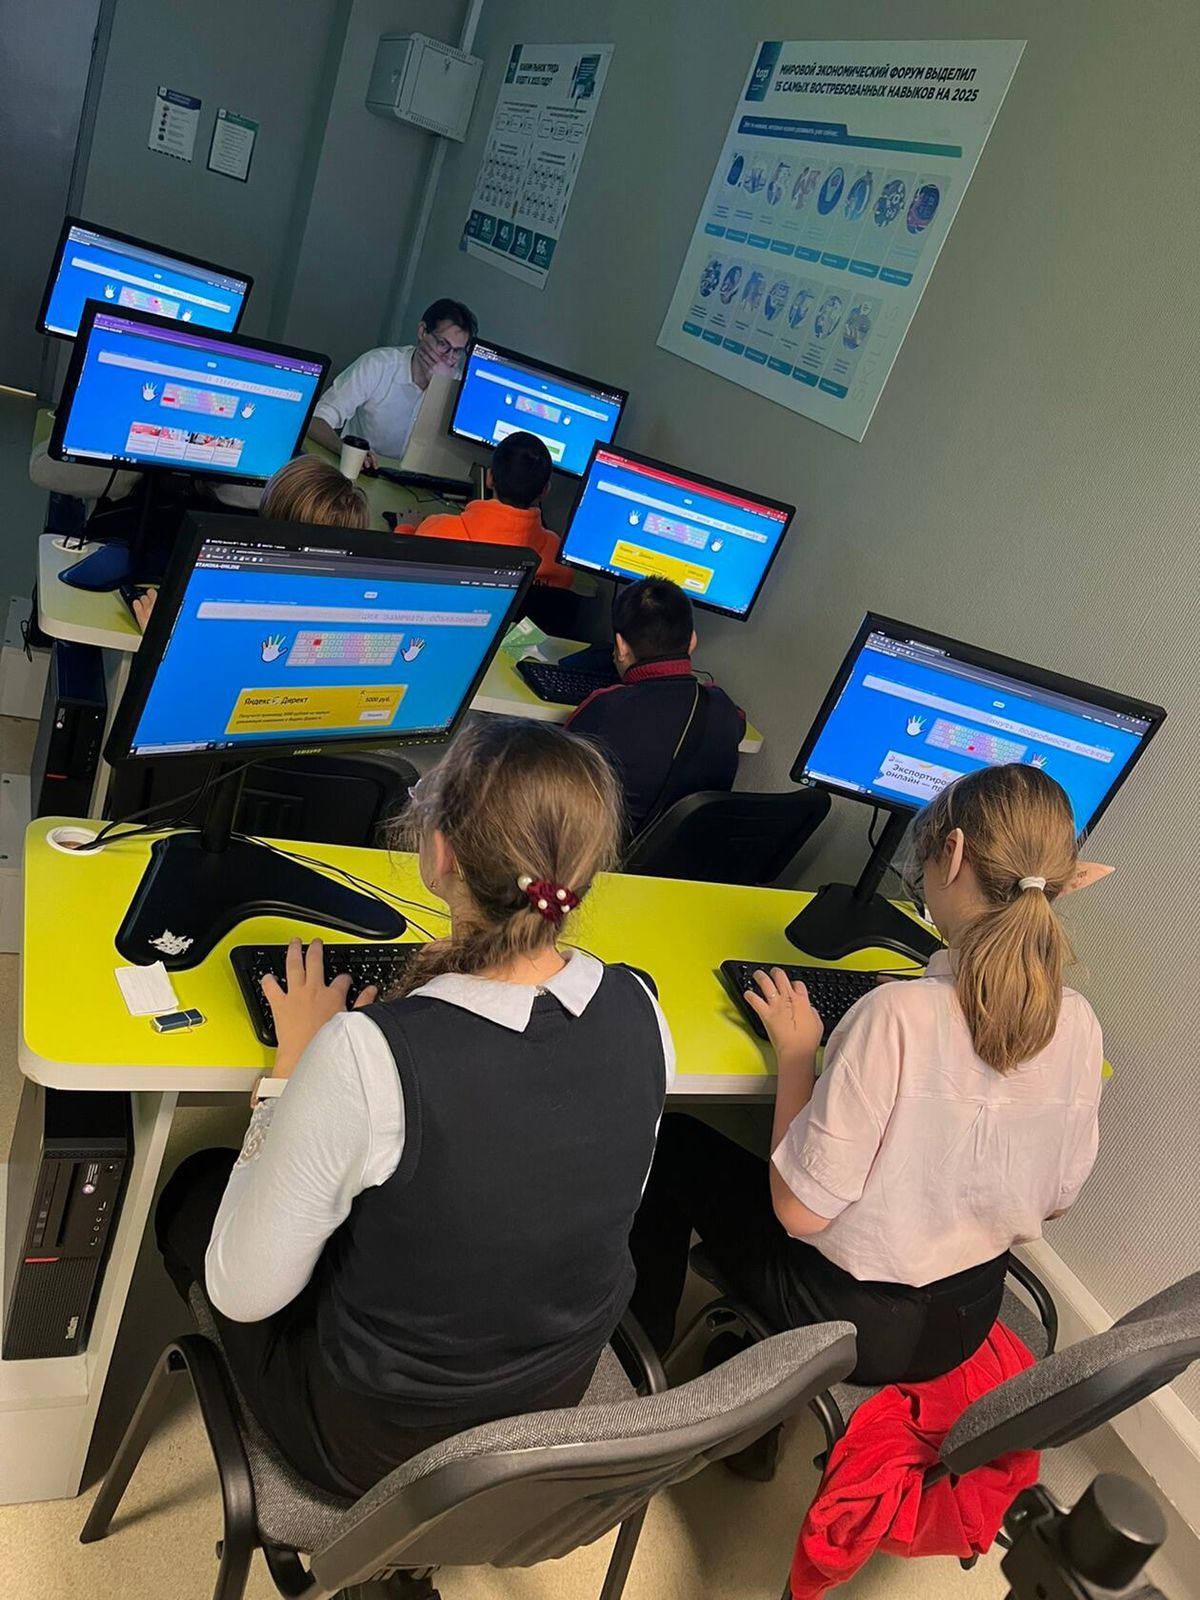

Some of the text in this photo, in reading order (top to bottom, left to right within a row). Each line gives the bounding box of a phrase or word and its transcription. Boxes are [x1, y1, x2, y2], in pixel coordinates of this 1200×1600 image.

[780, 63, 977, 82] МИРОВОЙ ЭКОНОМИЧЕСКИЙ ФОРУМ ВЫДЕЛИЛ
[782, 81, 809, 93] САМЫХ
[809, 82, 888, 97] ВОСТРЕБОВАННЫХ
[887, 86, 936, 99] НАВЫКОВ
[936, 87, 951, 100] НА
[951, 88, 979, 102] 2025
[885, 770, 920, 785] онлайн
[892, 763, 949, 786] Экспортиро
